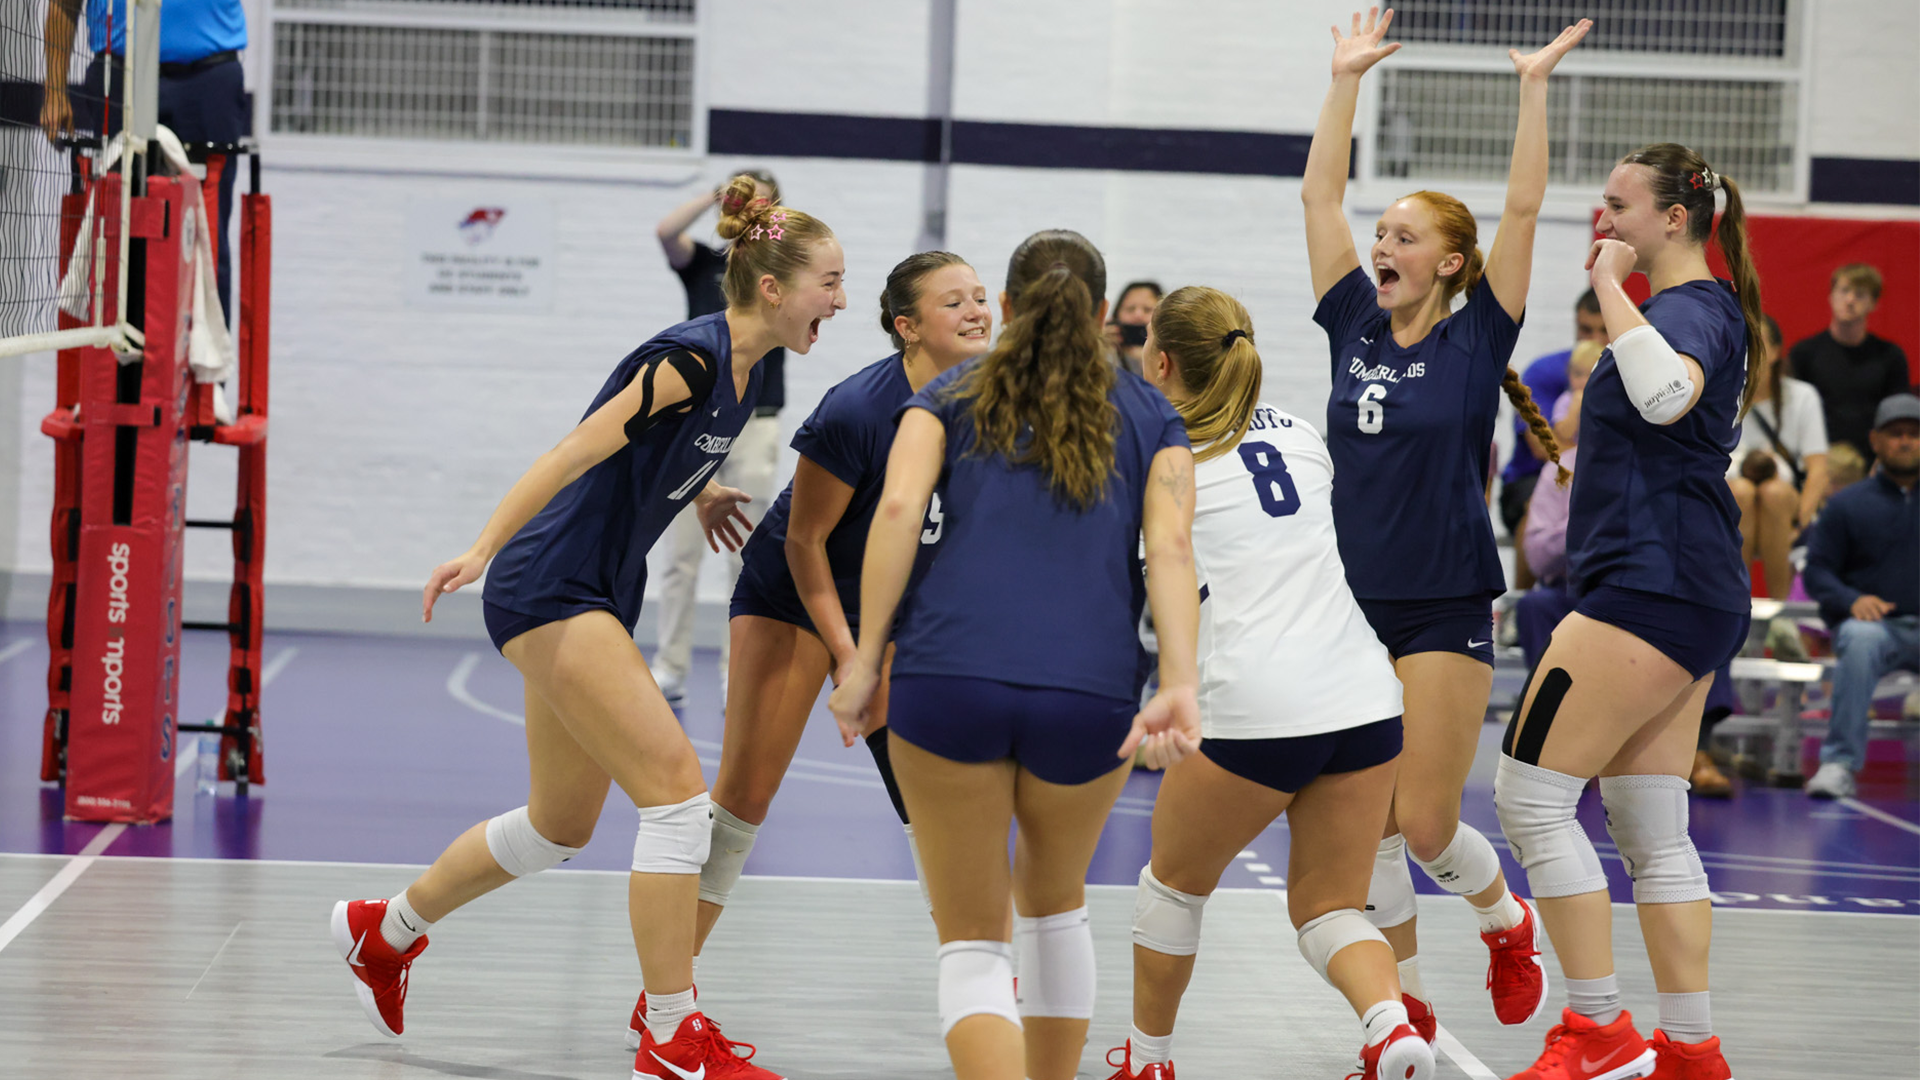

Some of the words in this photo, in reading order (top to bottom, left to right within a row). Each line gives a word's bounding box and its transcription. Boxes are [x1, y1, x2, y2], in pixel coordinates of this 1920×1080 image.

[1357, 383, 1388, 435] 6
[1237, 440, 1302, 518] 8
[107, 542, 130, 623] sports
